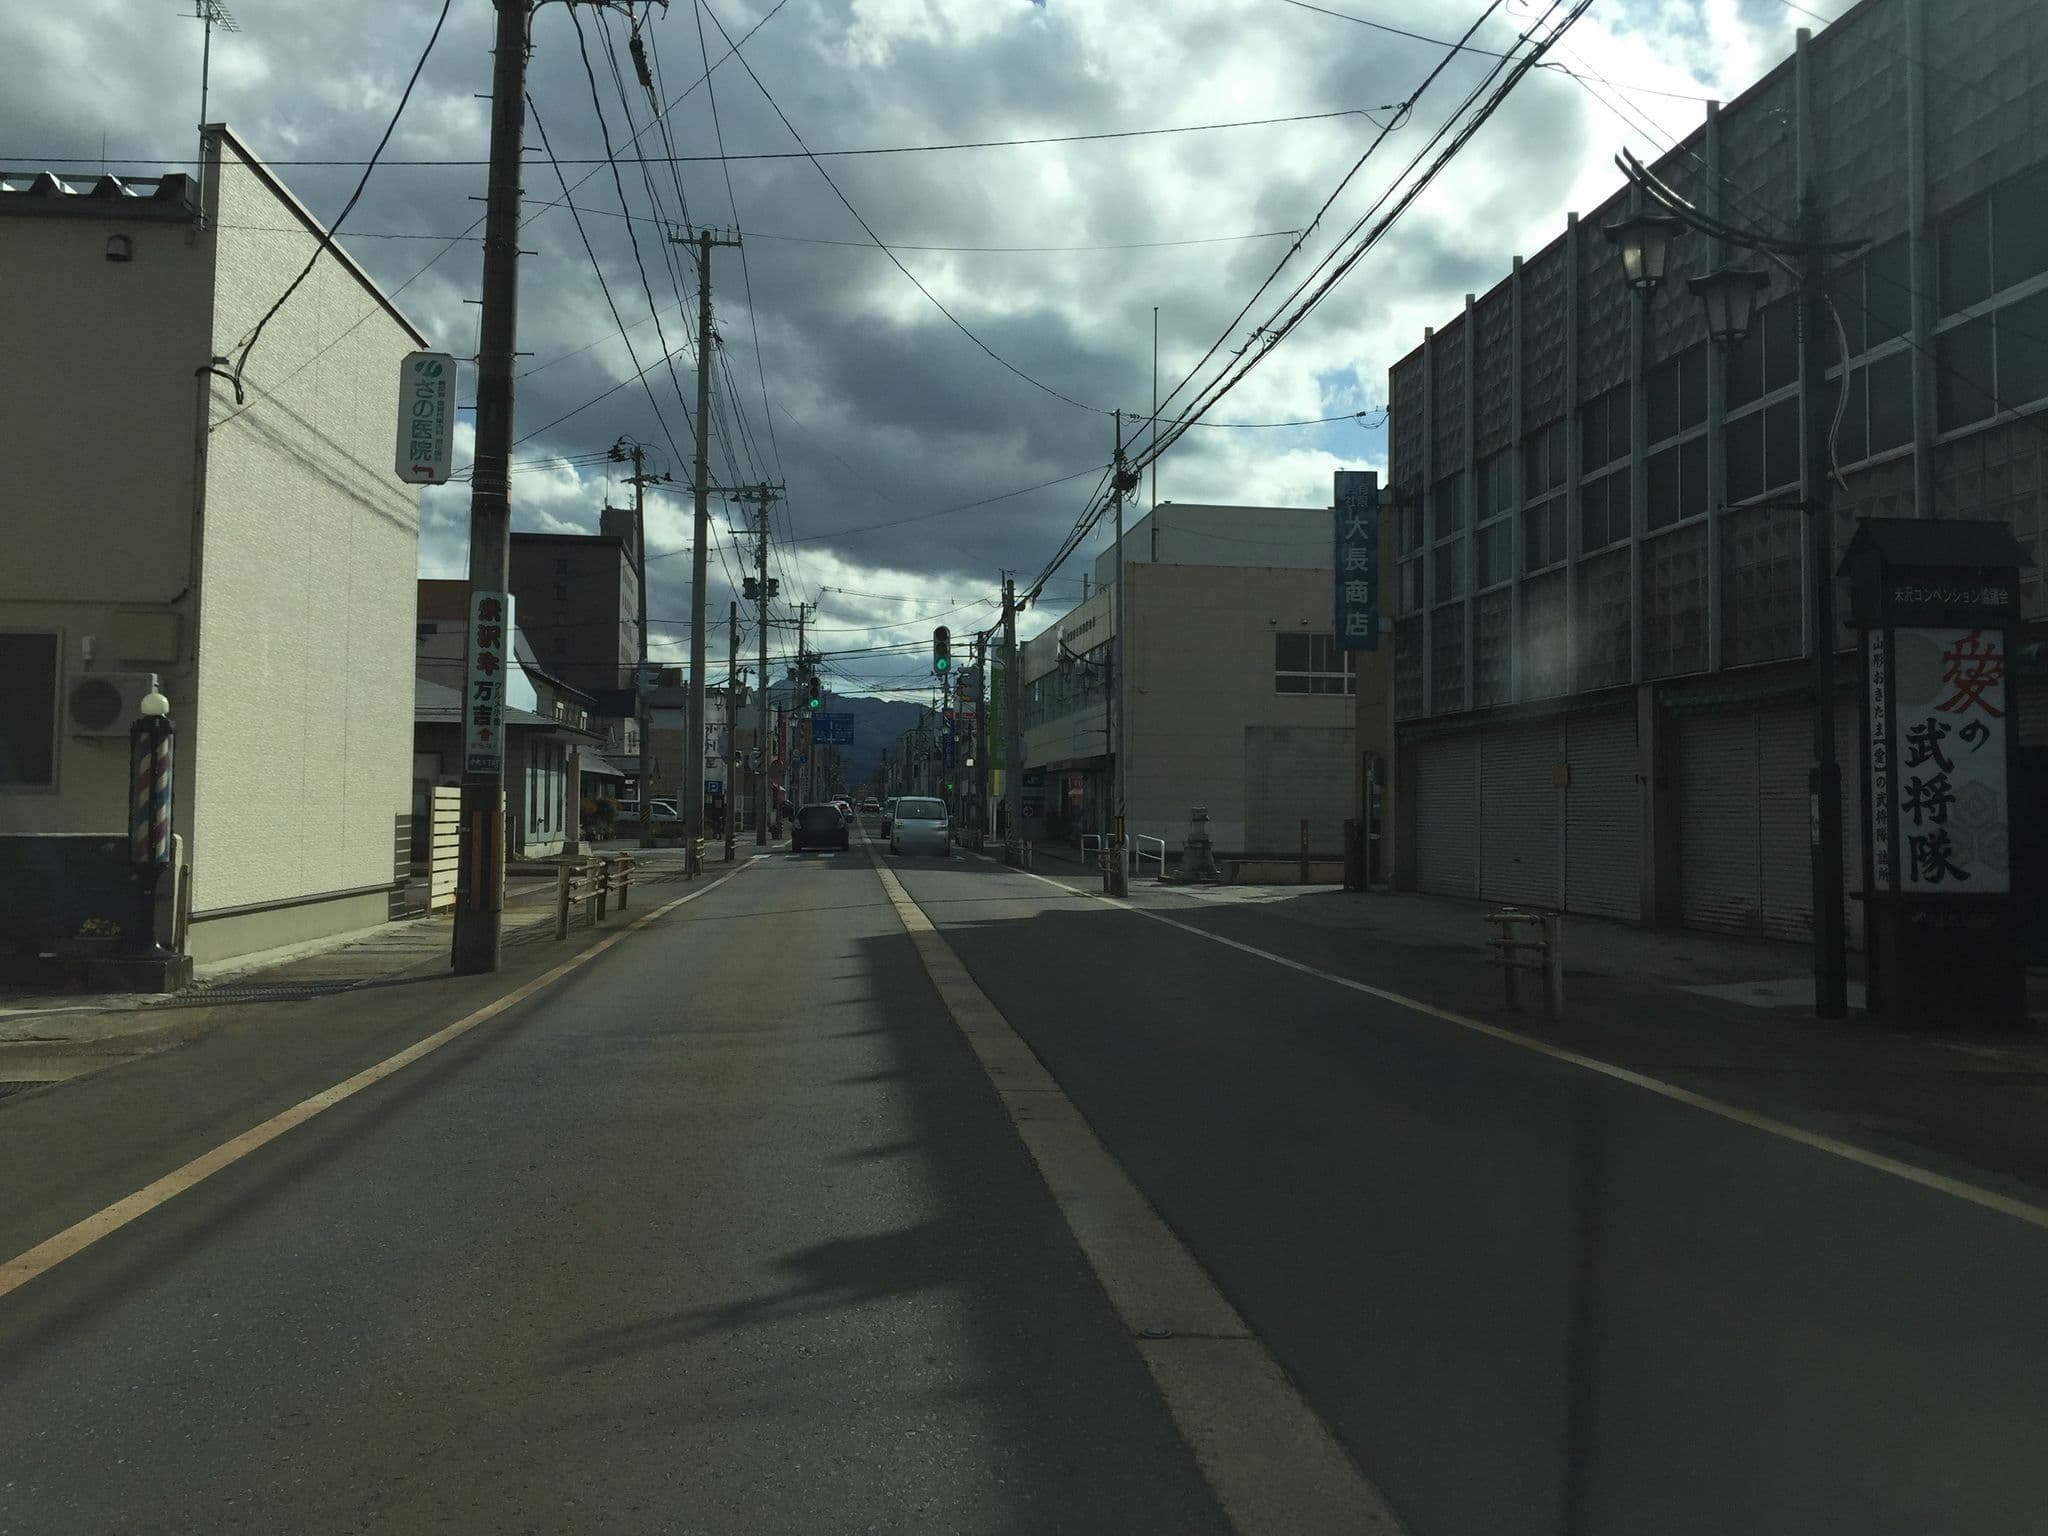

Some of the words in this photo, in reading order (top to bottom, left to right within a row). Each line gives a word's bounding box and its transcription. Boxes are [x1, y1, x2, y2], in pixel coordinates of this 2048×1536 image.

[1344, 515, 1369, 636] 大長商店
[472, 681, 494, 726] 万吉
[1901, 717, 1971, 884] 武将隊
